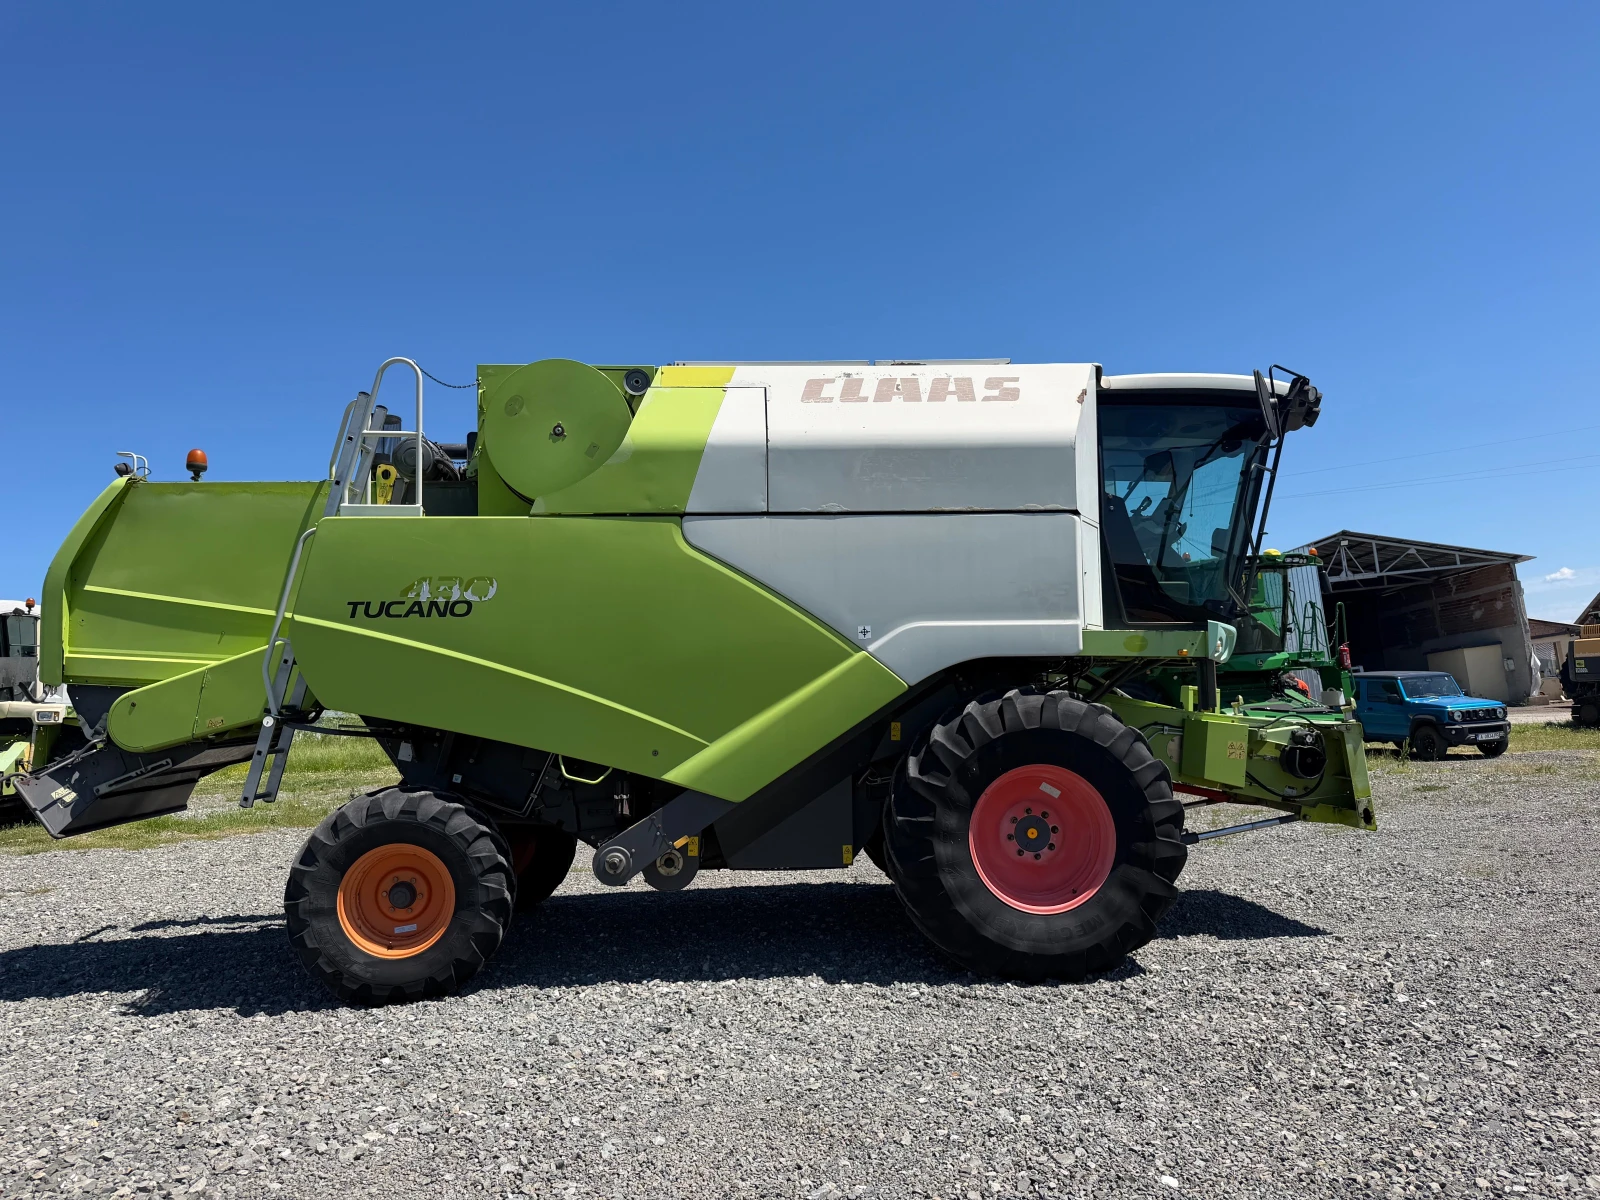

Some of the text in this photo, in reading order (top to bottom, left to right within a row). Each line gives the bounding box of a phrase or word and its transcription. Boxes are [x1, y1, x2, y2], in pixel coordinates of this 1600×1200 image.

[801, 377, 1021, 403] CLAAS
[400, 576, 498, 601] 430
[347, 600, 473, 618] TUCANO
